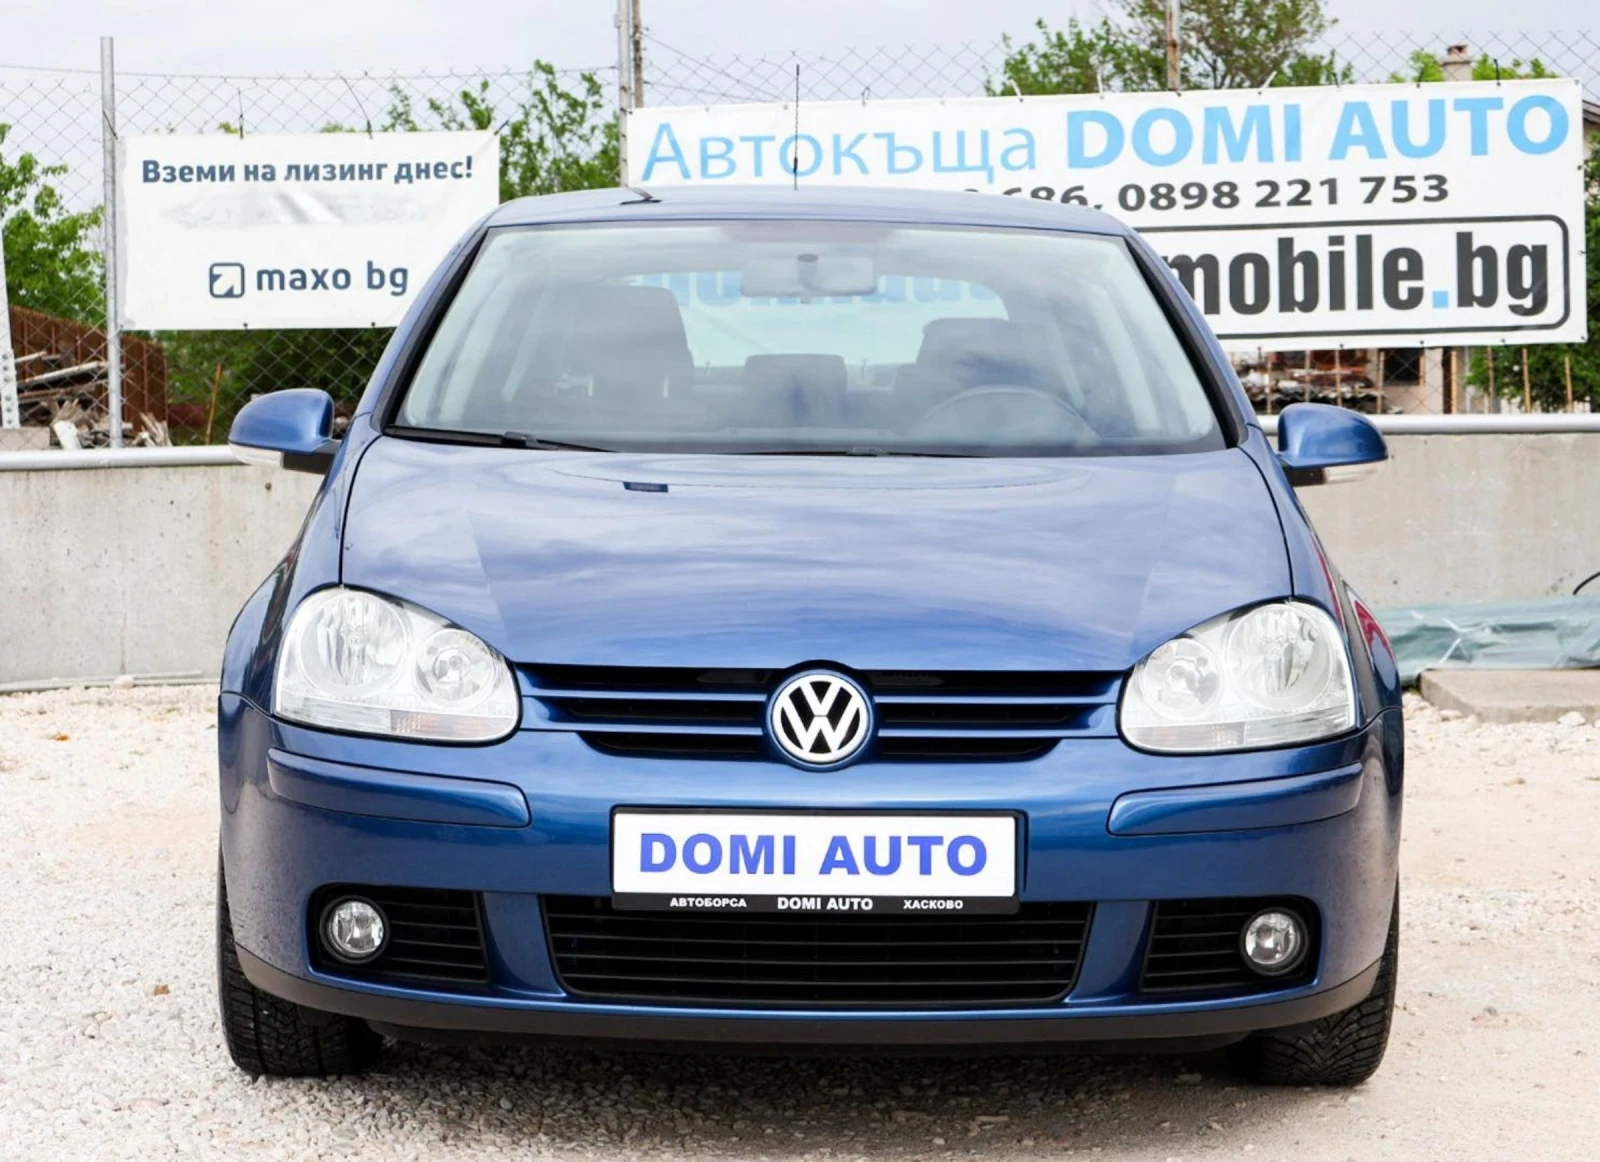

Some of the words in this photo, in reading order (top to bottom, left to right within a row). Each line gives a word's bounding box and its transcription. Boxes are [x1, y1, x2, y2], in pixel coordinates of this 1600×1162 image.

[641, 122, 1036, 184] Автокъща
[1066, 103, 1302, 169] DOMI
[1329, 94, 1569, 160] AUTO
[142, 159, 235, 184] Вземи
[243, 163, 277, 182] на
[284, 163, 388, 182] лизинг
[393, 155, 473, 185] днес!
[1117, 180, 1240, 212] 0898
[1254, 177, 1339, 208] 221
[1359, 173, 1449, 205] 753
[256, 268, 352, 291] maxo
[366, 260, 409, 296] bg
[1161, 231, 1549, 317] mobile.bg
[639, 832, 797, 876] DOMI
[818, 834, 988, 877] AUTO
[669, 896, 747, 909] АВТОБОРСА
[776, 896, 822, 911] DOMI
[826, 897, 873, 911] AUTO
[902, 899, 964, 910] ХАСКОВО
